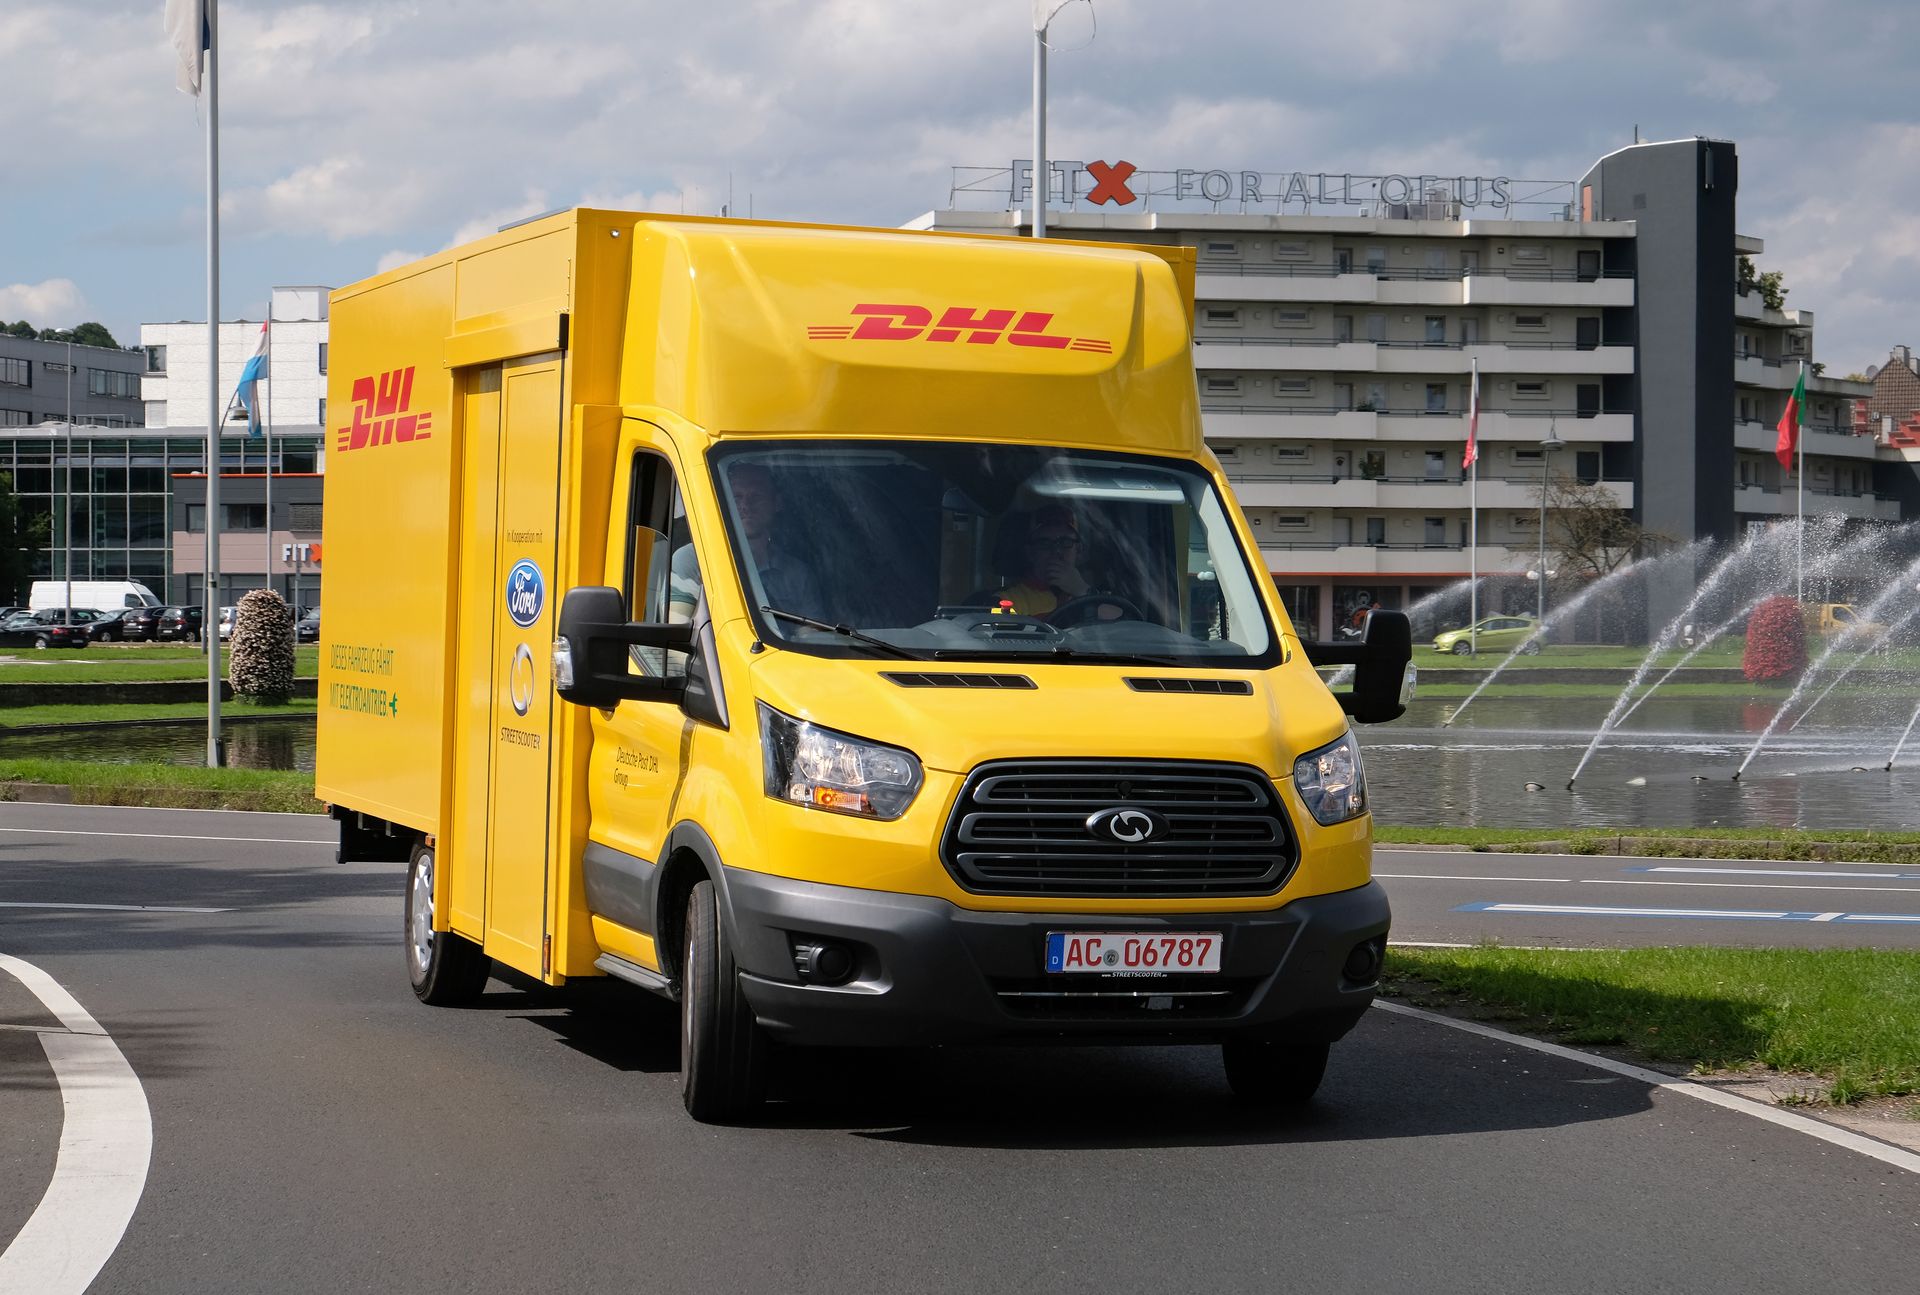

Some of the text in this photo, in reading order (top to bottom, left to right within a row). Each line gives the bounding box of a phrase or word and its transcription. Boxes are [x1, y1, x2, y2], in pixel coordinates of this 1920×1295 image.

[1176, 169, 1262, 203] FOR
[1283, 172, 1361, 205] ALL
[1380, 174, 1437, 206] OF
[1459, 176, 1510, 208] US
[849, 303, 1073, 350] DHL
[348, 366, 418, 450] DHL
[511, 529, 535, 547] Kooperation
[535, 528, 543, 543] mit
[512, 569, 538, 615] Ford
[330, 643, 394, 677] DIESES FAHRZEUG FÄHRT
[329, 682, 339, 708] MIT
[500, 726, 541, 750] STREETSCOOTER
[616, 746, 659, 773] Deutsche Post DHL
[613, 767, 629, 791] Group
[1052, 938, 1212, 967] D AC 06787
